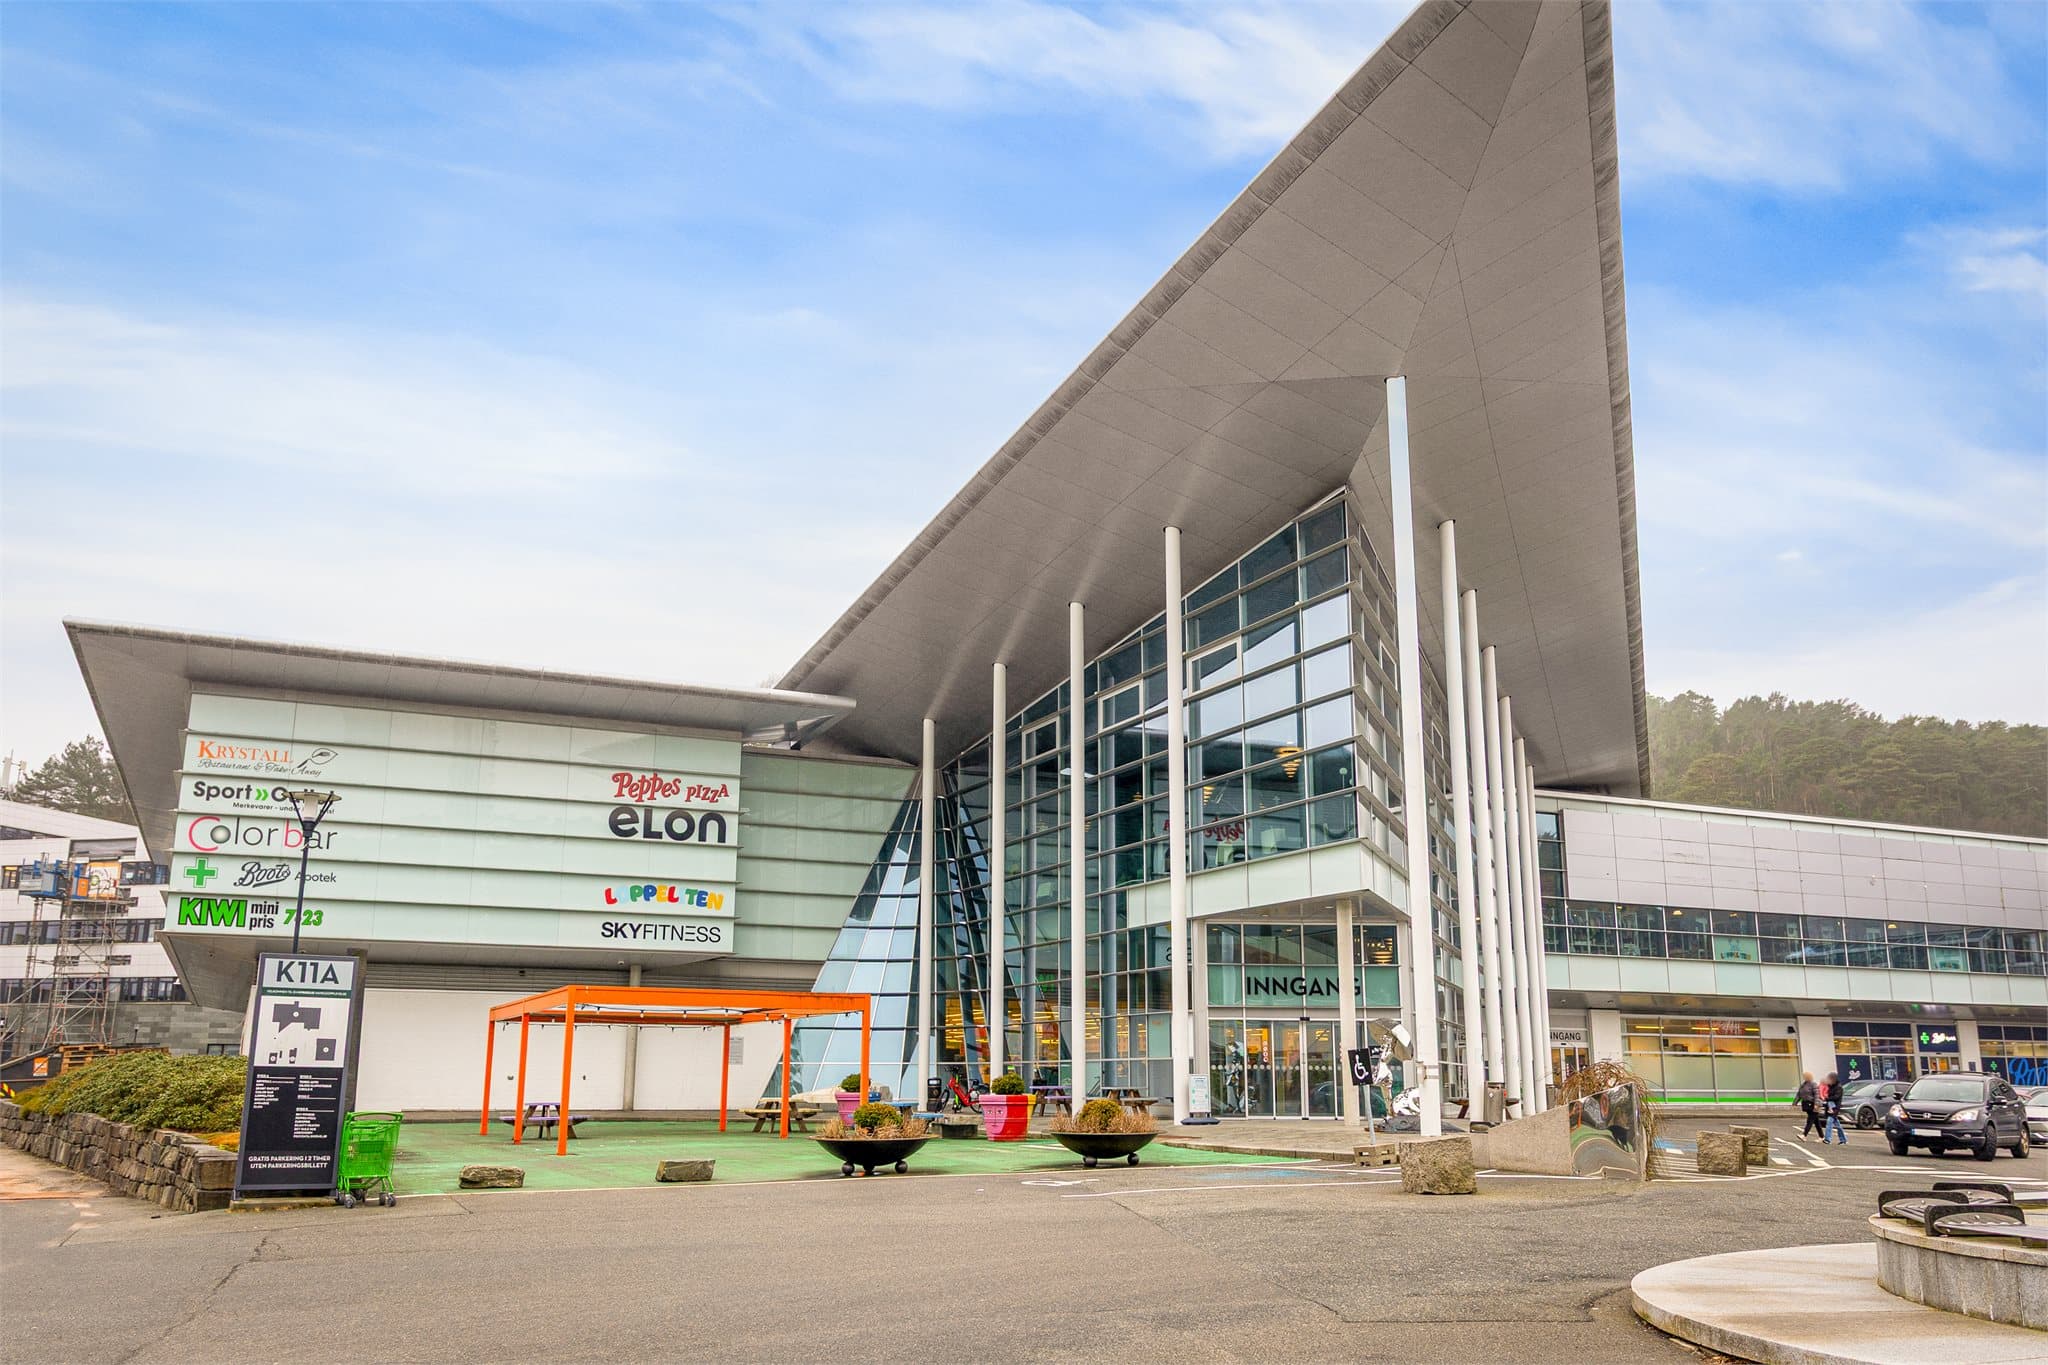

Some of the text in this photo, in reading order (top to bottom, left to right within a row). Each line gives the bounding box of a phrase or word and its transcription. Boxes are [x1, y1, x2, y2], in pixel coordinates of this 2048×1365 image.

[197, 740, 291, 763] KRYSTALL
[198, 758, 251, 771] Restaurant
[193, 780, 253, 801] Sport
[612, 772, 681, 802] Peppes
[233, 802, 273, 811] Merkevarer
[233, 861, 337, 888] Boots Apotek
[178, 897, 279, 928] KIWI mini
[249, 915, 275, 930] pris
[601, 922, 721, 943] SKYFITNESS
[276, 960, 339, 984] K11A
